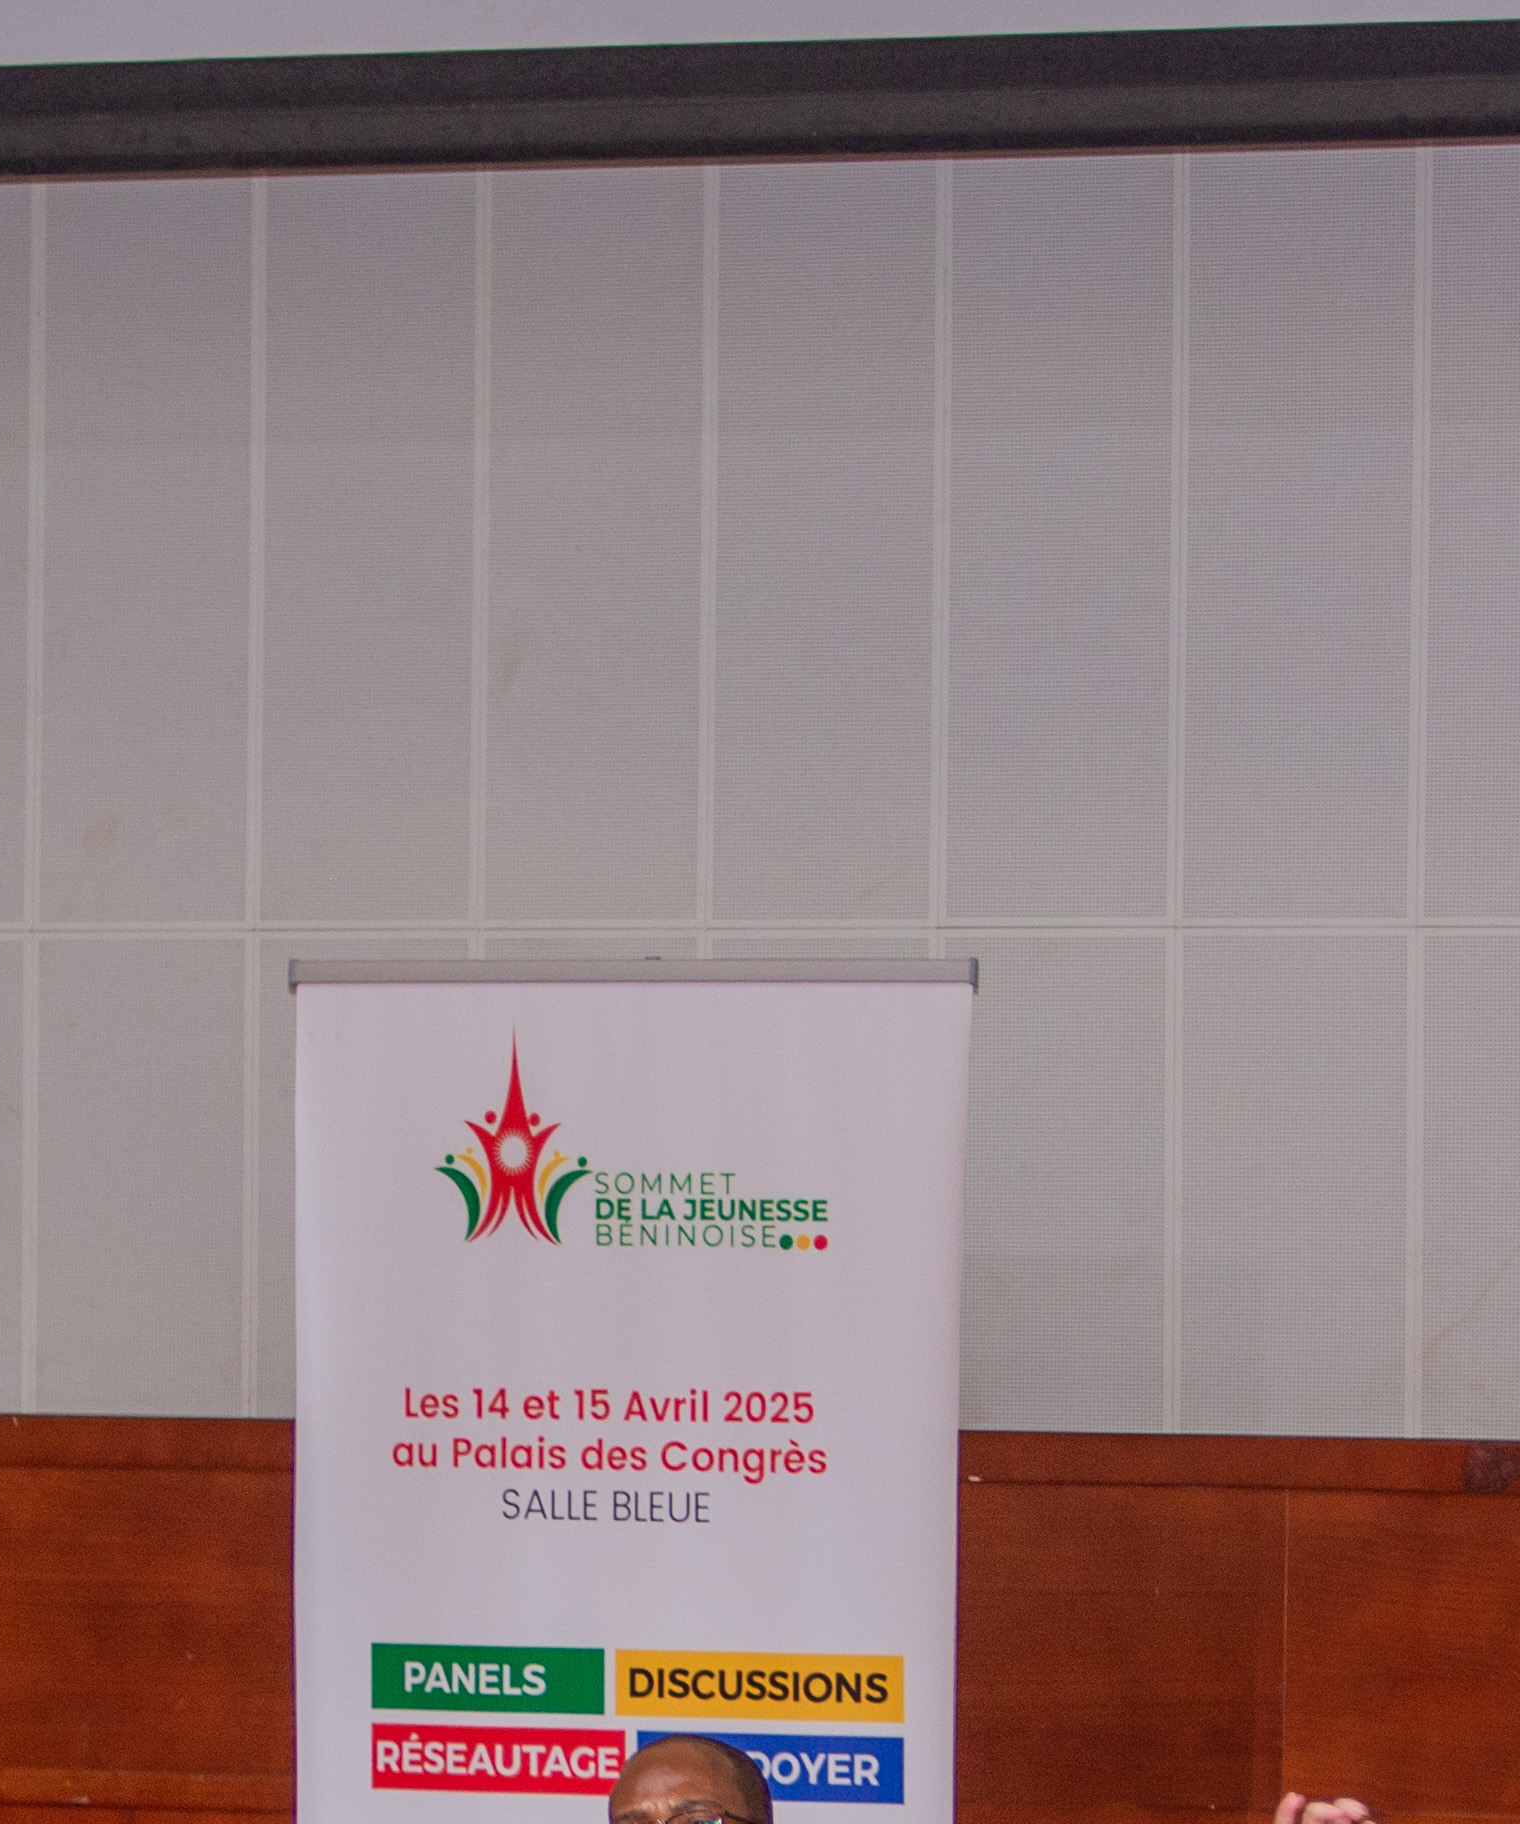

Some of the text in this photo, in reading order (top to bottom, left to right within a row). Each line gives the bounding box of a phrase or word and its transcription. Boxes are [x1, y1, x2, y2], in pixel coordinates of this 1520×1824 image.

[595, 1172, 735, 1195] SOMMET
[596, 1198, 827, 1221] DE LA JEUNESSE
[596, 1219, 776, 1248] BÉNINOISE
[405, 1388, 814, 1423] Les 14 et 15 Avril 2025
[393, 1436, 826, 1484] au Palais des Congrès
[503, 1489, 709, 1522] SALLE BLEUE
[405, 1661, 546, 1695] PANELS
[630, 1668, 888, 1703] DISCUSSIONS
[376, 1733, 620, 1778] RÉSEAUTAGE
